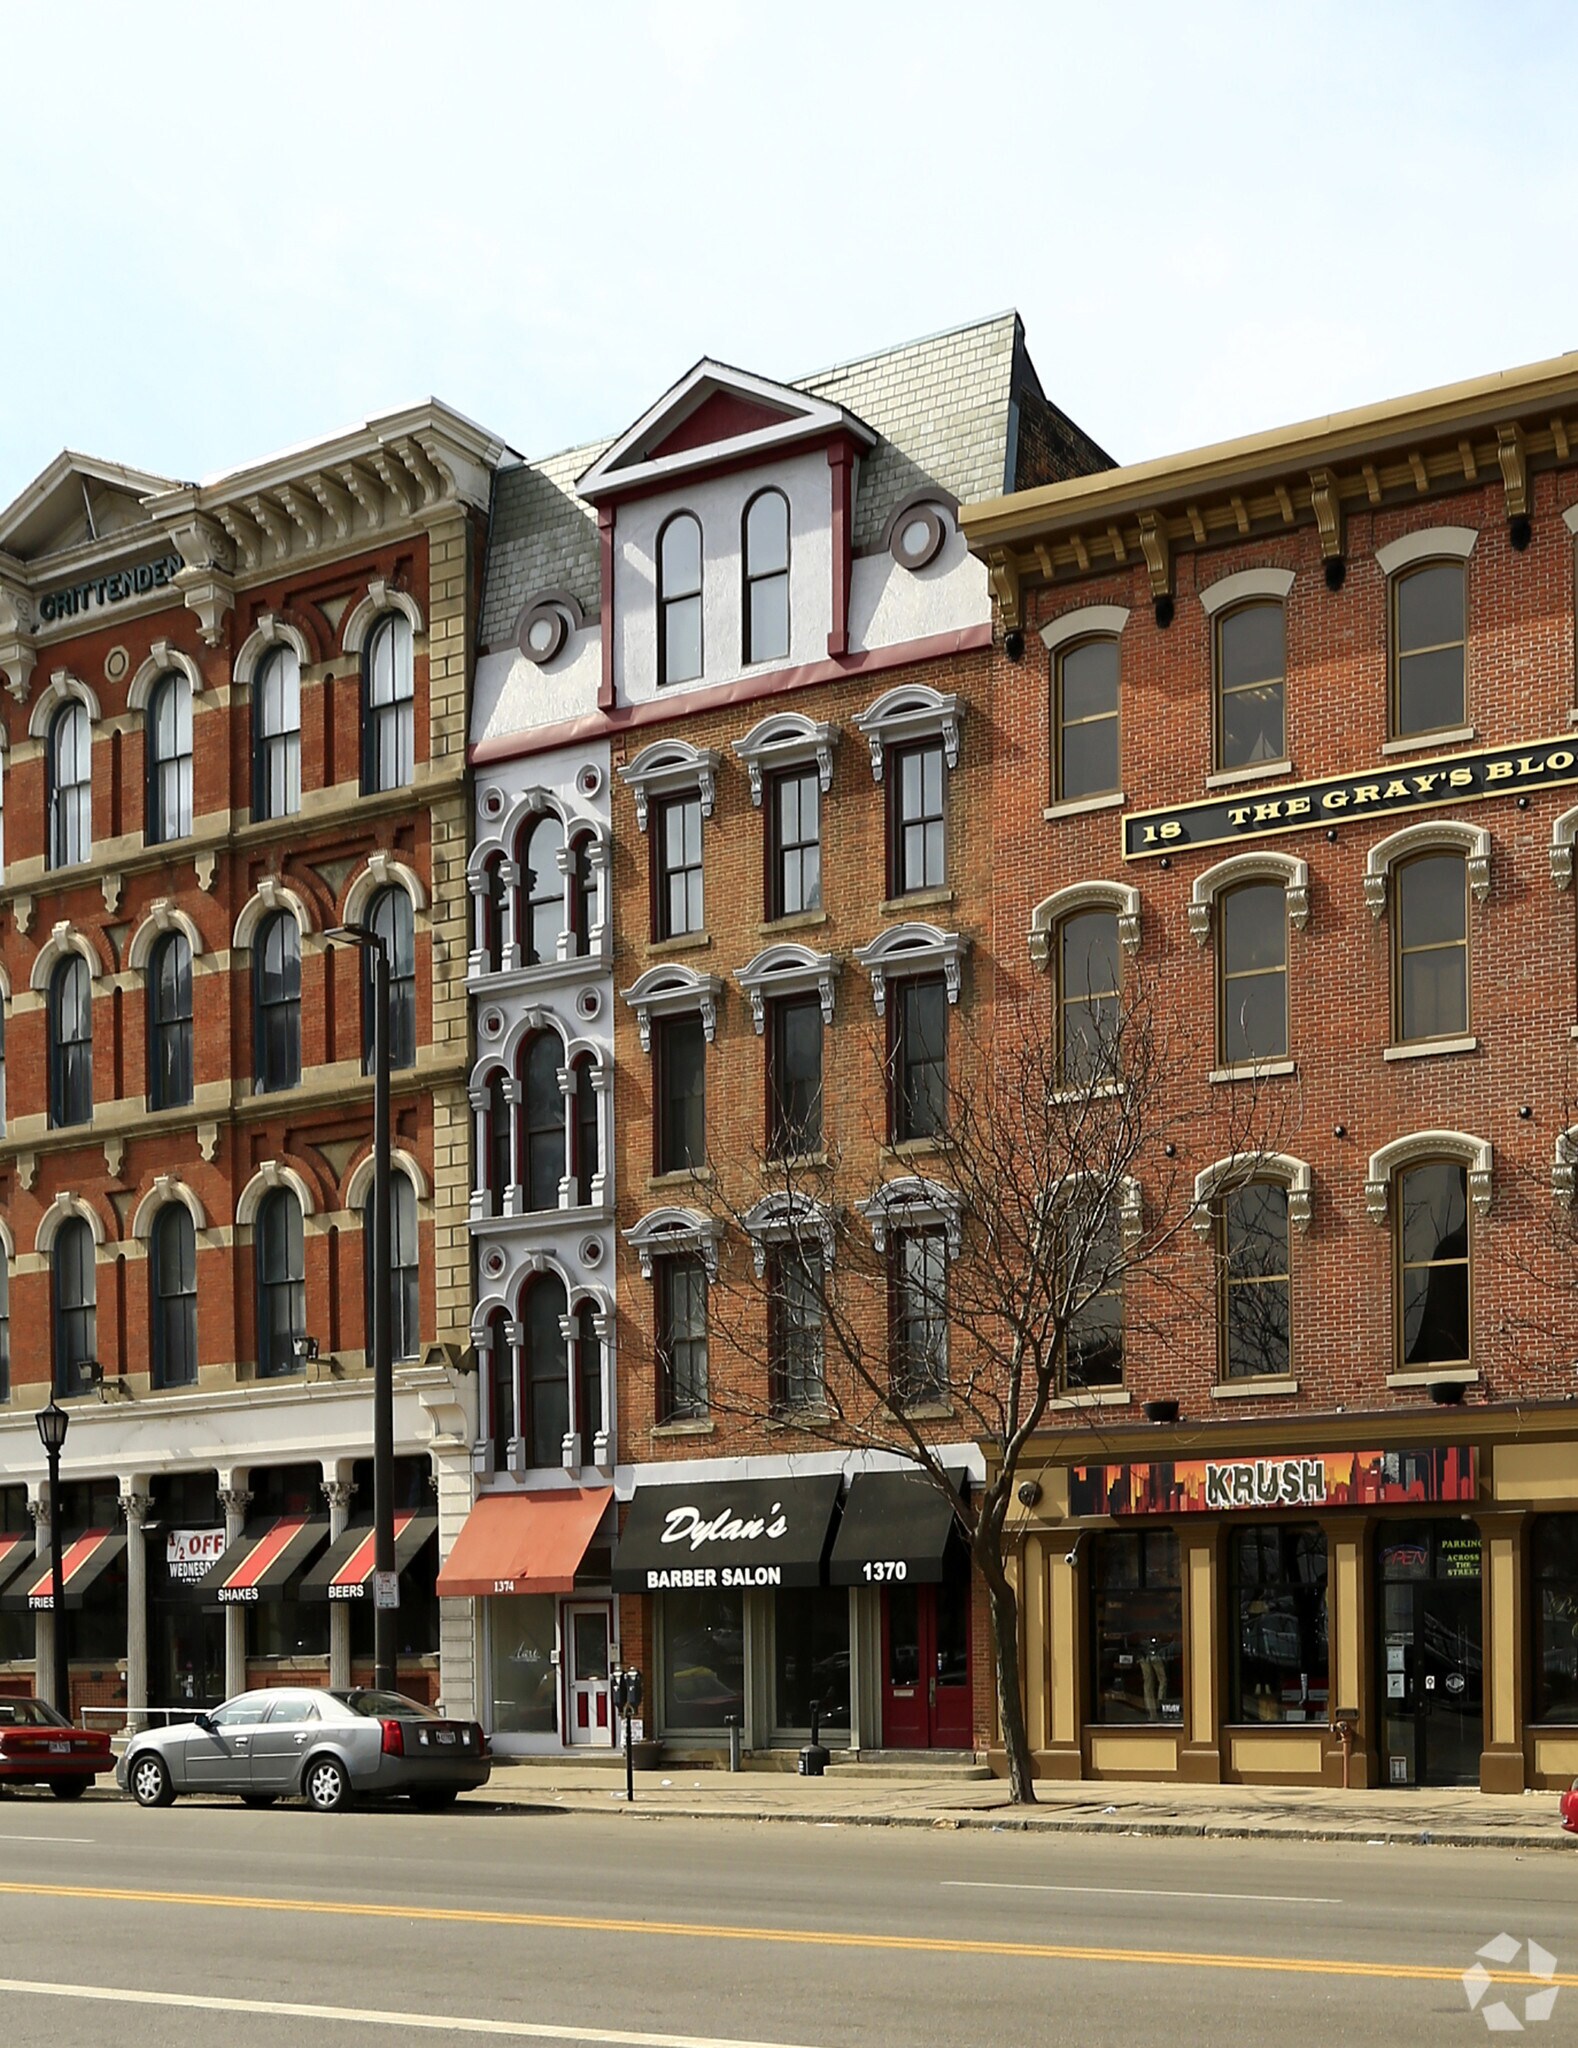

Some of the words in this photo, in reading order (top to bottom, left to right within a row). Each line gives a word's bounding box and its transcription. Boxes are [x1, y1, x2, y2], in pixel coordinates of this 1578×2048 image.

[39, 554, 184, 621] CRITTENDEN
[1142, 821, 1182, 843] 18
[1228, 796, 1312, 826] THE
[1322, 768, 1474, 809] GRAY'S
[1485, 751, 1578, 781] BLO
[1206, 1460, 1327, 1509] KRUSH
[660, 1502, 788, 1552] Dylan's
[189, 1534, 224, 1555] OFF
[1446, 1554, 1480, 1562] ACROSS
[169, 1561, 216, 1578] WEDNESD
[647, 1568, 717, 1590] BARBER
[721, 1566, 782, 1588] SALON
[863, 1560, 907, 1582] 1370
[1447, 1569, 1480, 1577] STREET
[217, 1587, 259, 1602] SHAKES
[328, 1584, 364, 1599] BEERS
[494, 1580, 514, 1593] 1374
[28, 1597, 54, 1609] FRIES
